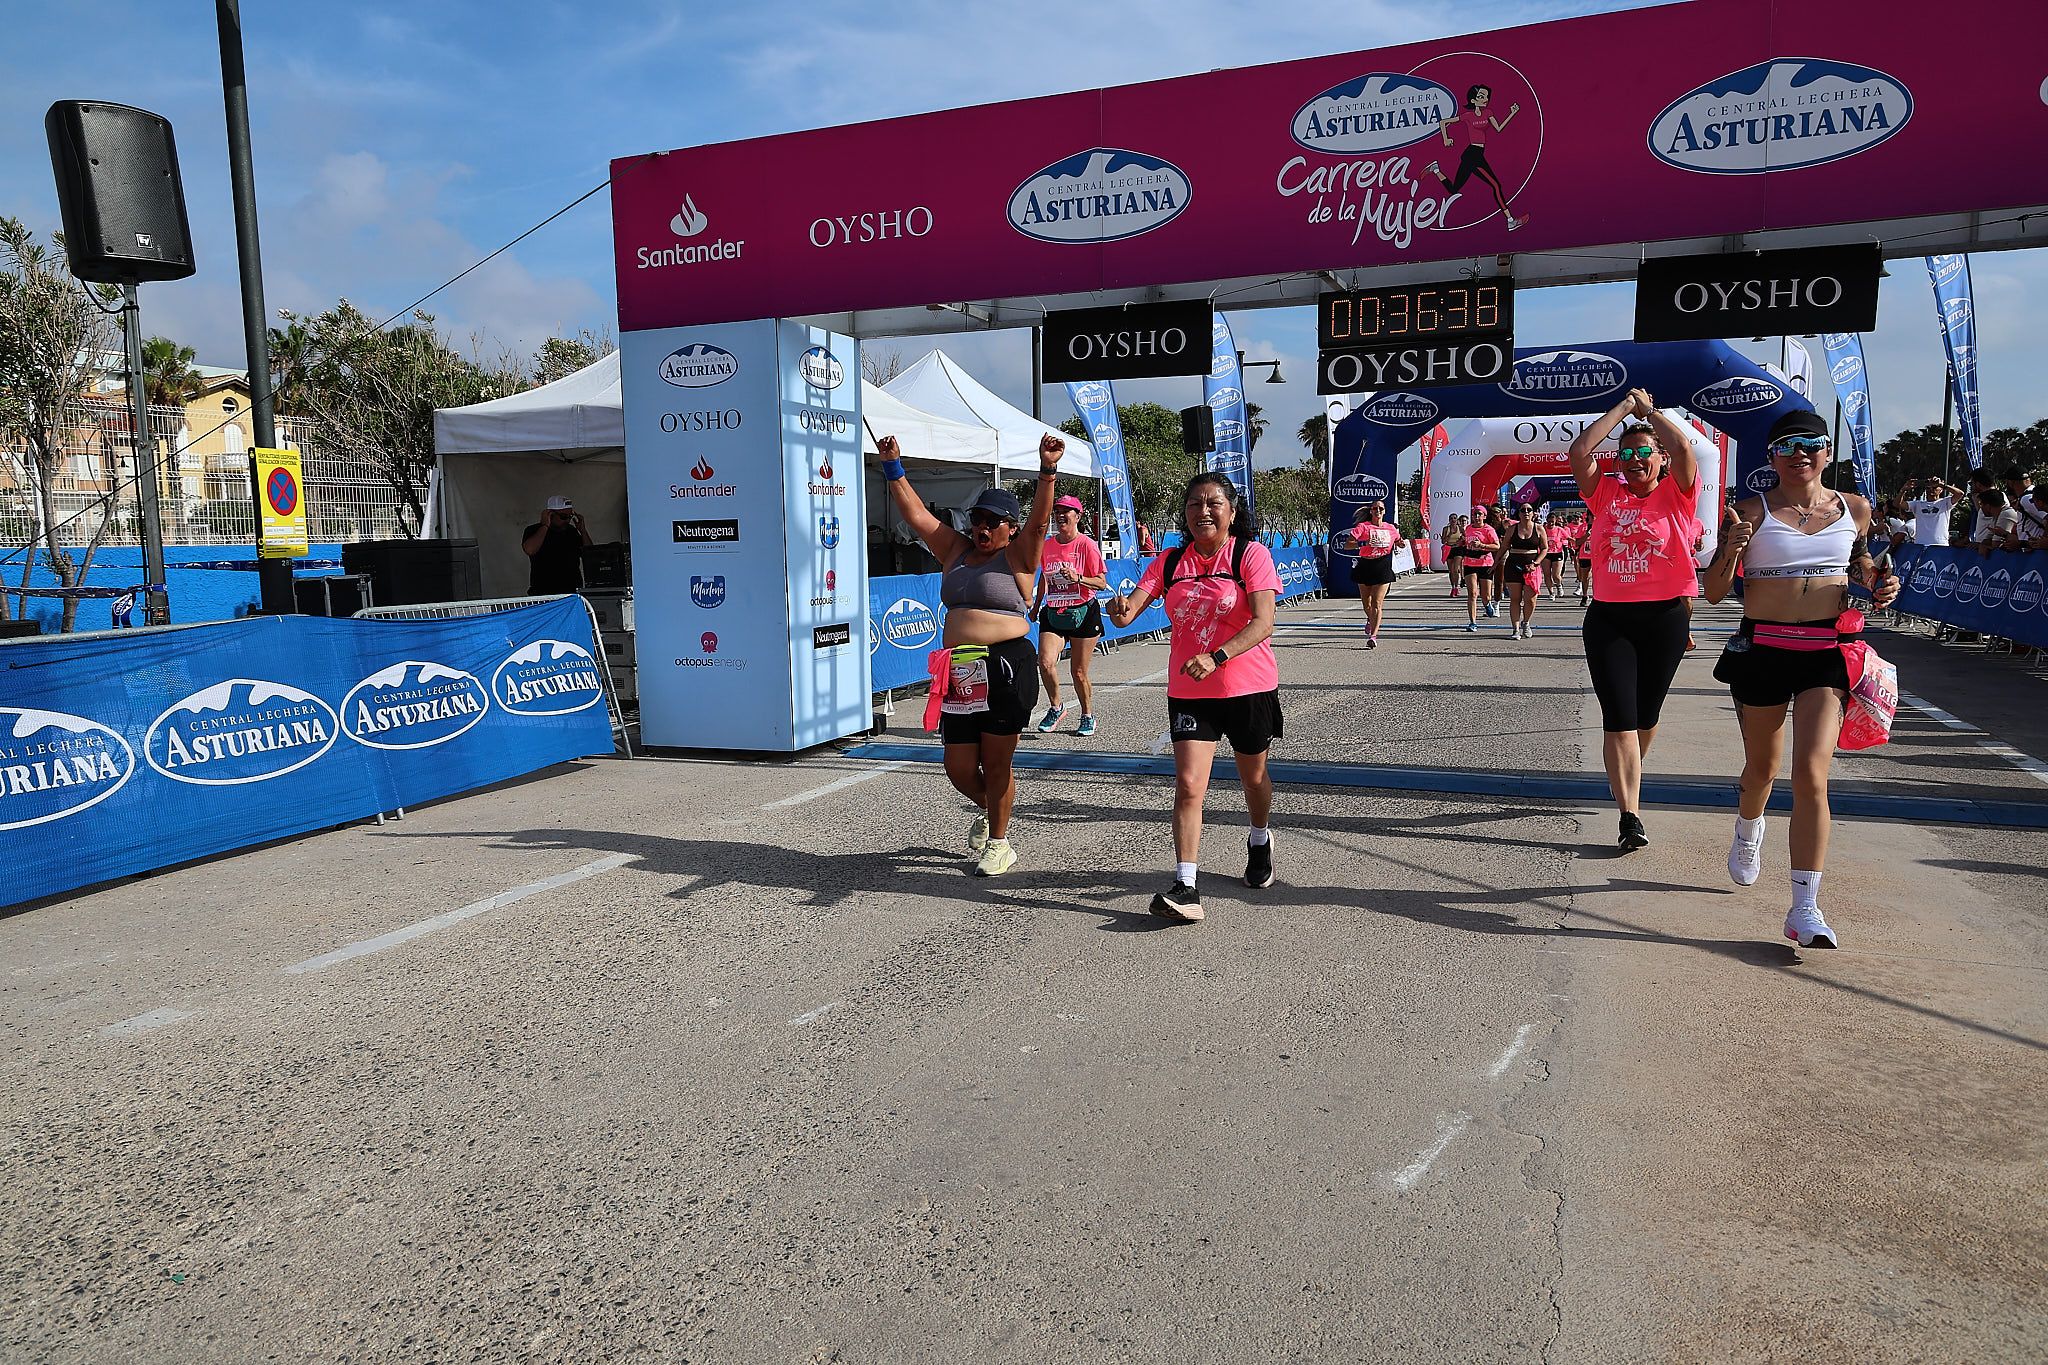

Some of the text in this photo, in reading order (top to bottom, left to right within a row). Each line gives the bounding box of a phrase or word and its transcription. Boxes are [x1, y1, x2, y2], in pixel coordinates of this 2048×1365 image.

[1328, 93, 1439, 114] CENTRAL LECHERA
[1707, 86, 1883, 117] CENTRAL LECHERA
[1303, 104, 1443, 140] ASTURIANA
[1666, 102, 1891, 154] ASTURIANA
[1048, 174, 1170, 195] CENTRAL LECHERA
[1276, 156, 1411, 197] Carrera
[1021, 187, 1177, 226] ASTURIANA
[1308, 180, 1463, 249] de la Mujer
[809, 206, 934, 248] OYSHO
[637, 238, 745, 269] Santander
[1673, 276, 1843, 313] OYSHO
[1331, 286, 1499, 338] 00:36:38
[1068, 328, 1187, 360] OYSHO
[665, 362, 733, 378] ASTURIANA
[803, 360, 841, 382] ASTURIANA
[1327, 343, 1503, 388] OYSHO
[1571, 363, 1613, 371] LECHERA
[1507, 369, 1617, 390] ASTURIANA
[1700, 390, 1778, 407] ASTURIANA
[660, 409, 742, 434] OYSHO
[800, 409, 846, 434] OYSHO
[1367, 406, 1432, 418] ASTURIANA
[1513, 420, 1628, 444] OYSO
[1448, 448, 1481, 457] OYSHO
[1523, 453, 1555, 464] Sports
[670, 483, 737, 498] Santander
[807, 481, 846, 496] Santander
[1335, 485, 1386, 497] ASTURIANA
[1433, 490, 1464, 499] OYSHO
[677, 524, 735, 540] Neutrogena
[1607, 556, 1649, 573] MUJER
[1620, 574, 1636, 583] 2026
[692, 582, 724, 600] Marlene
[815, 630, 848, 644] Neutrogena
[888, 619, 935, 640] ASTURIANA
[518, 665, 558, 678] CENTRAL
[374, 681, 471, 704] CENTRAL LECHERA
[505, 670, 600, 705] ASTURIANA
[1878, 686, 1898, 708] 016
[190, 704, 317, 732] CENTRAL LECHERA
[355, 692, 481, 736] ASTURIANA
[25, 735, 105, 756] LECHERA
[165, 718, 329, 769] ASTURIANA
